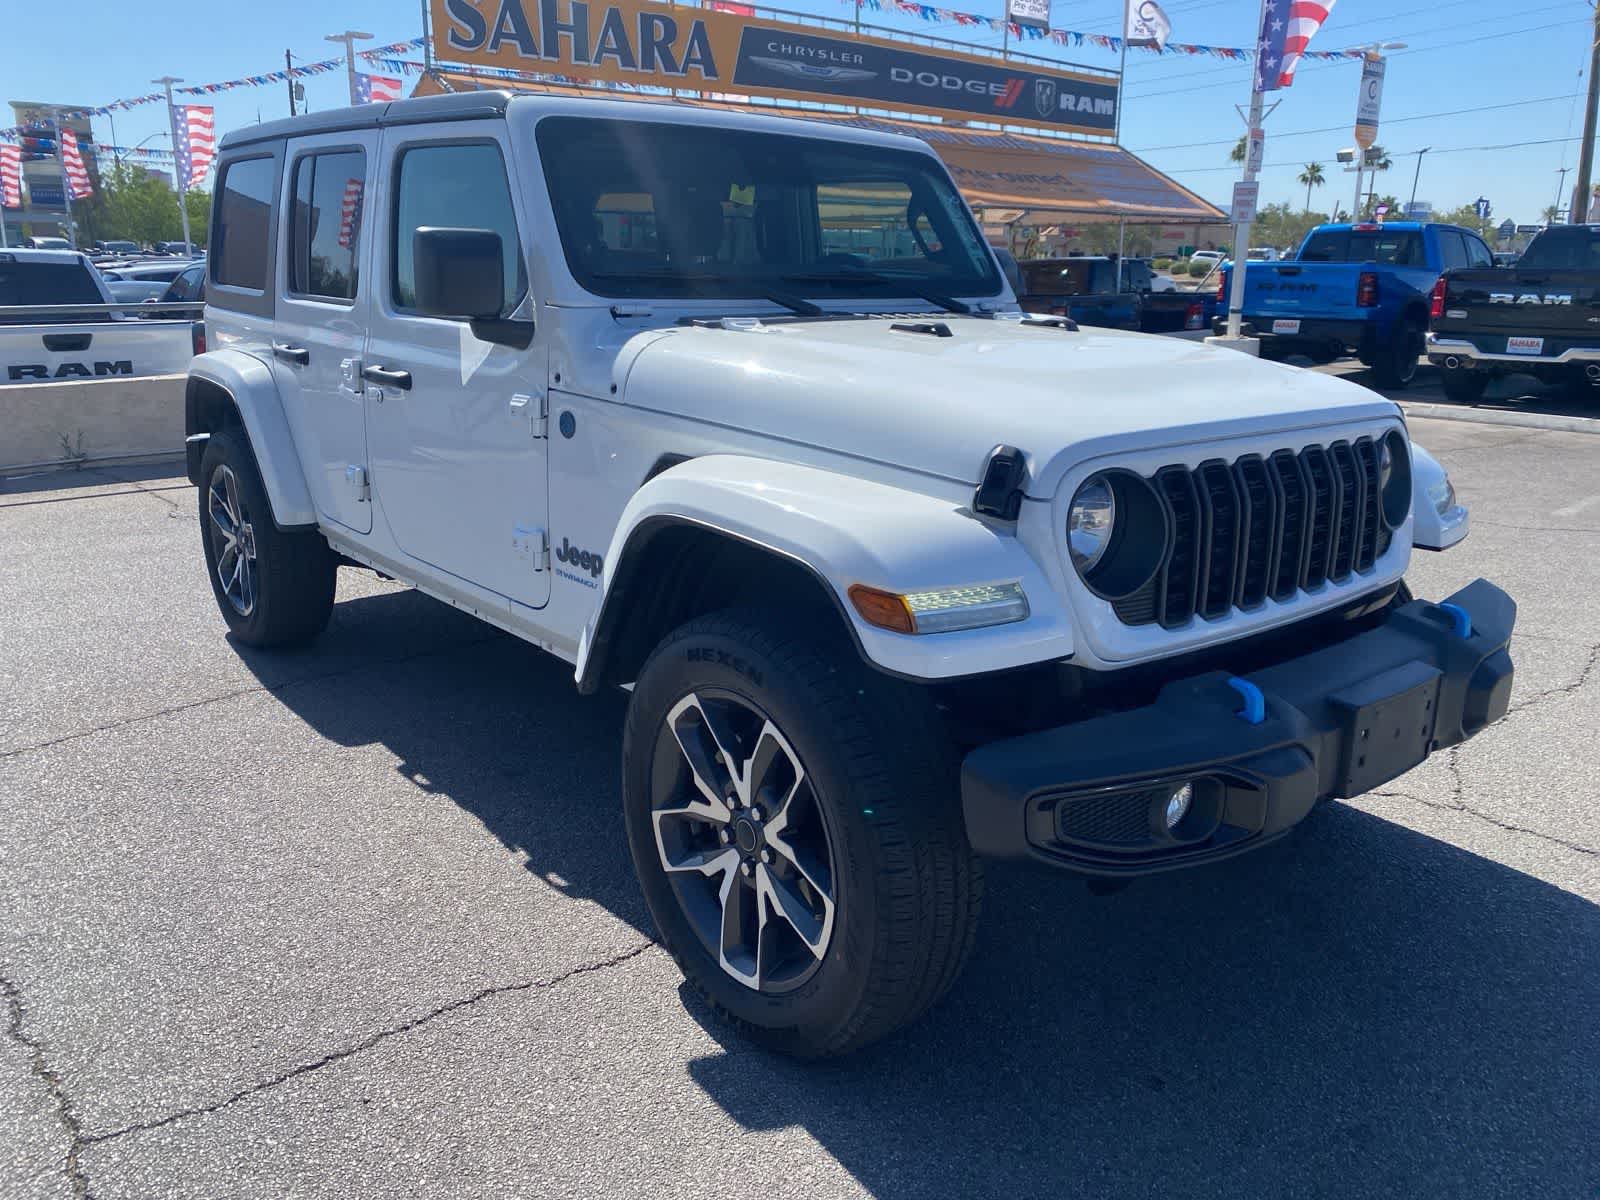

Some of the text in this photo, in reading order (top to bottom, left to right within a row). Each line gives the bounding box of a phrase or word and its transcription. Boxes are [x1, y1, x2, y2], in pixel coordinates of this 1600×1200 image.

[444, 0, 720, 81] SAHARA
[767, 41, 864, 65] CHRYSLER
[890, 66, 1010, 97] DODGE
[1060, 92, 1114, 117] RAM
[1488, 293, 1572, 305] RAM
[1509, 337, 1541, 348] SAHARA
[7, 360, 133, 380] RAM
[556, 536, 604, 578] Jeep
[687, 647, 764, 688] NEXEN
